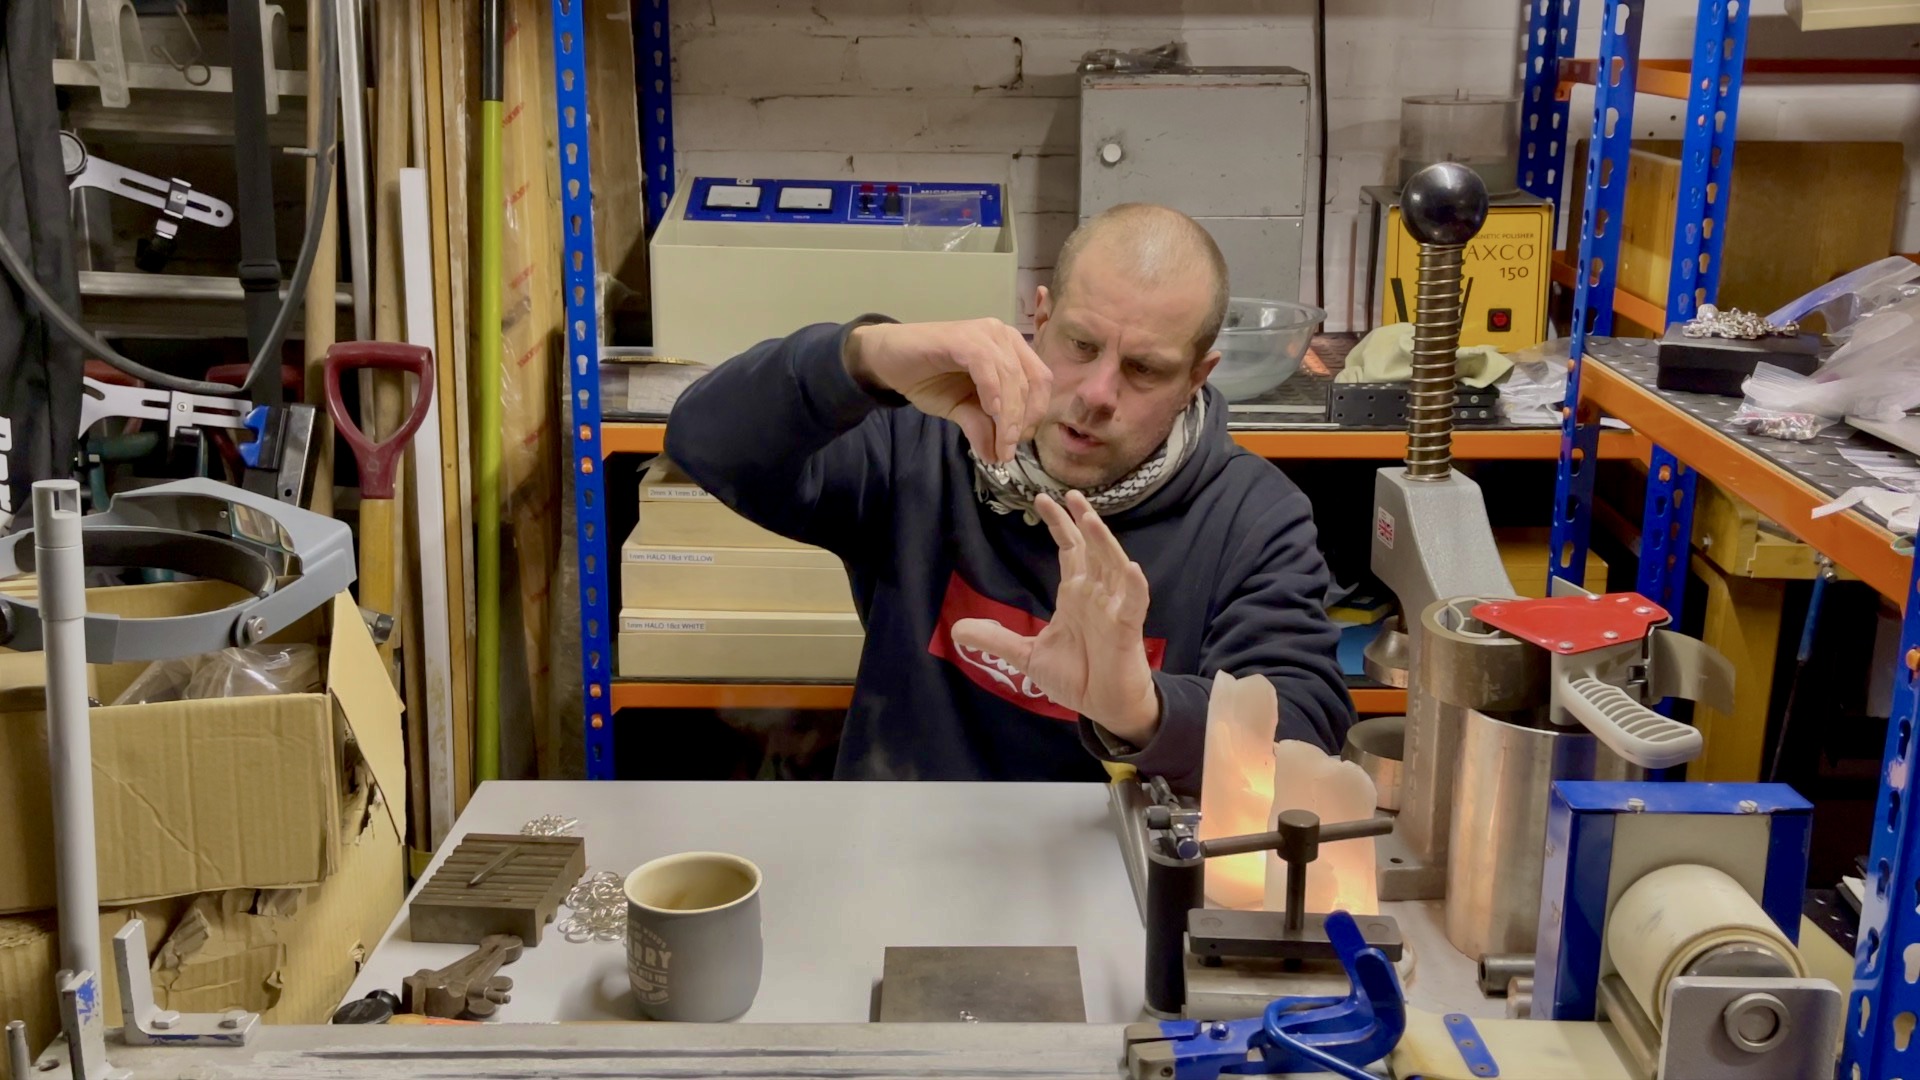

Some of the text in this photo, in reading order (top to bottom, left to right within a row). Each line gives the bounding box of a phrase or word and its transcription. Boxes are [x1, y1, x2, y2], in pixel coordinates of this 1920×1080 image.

[1499, 266, 1529, 281] 150
[646, 553, 666, 561] HALO
[683, 554, 713, 562] YELLOW
[644, 622, 664, 630] HALO
